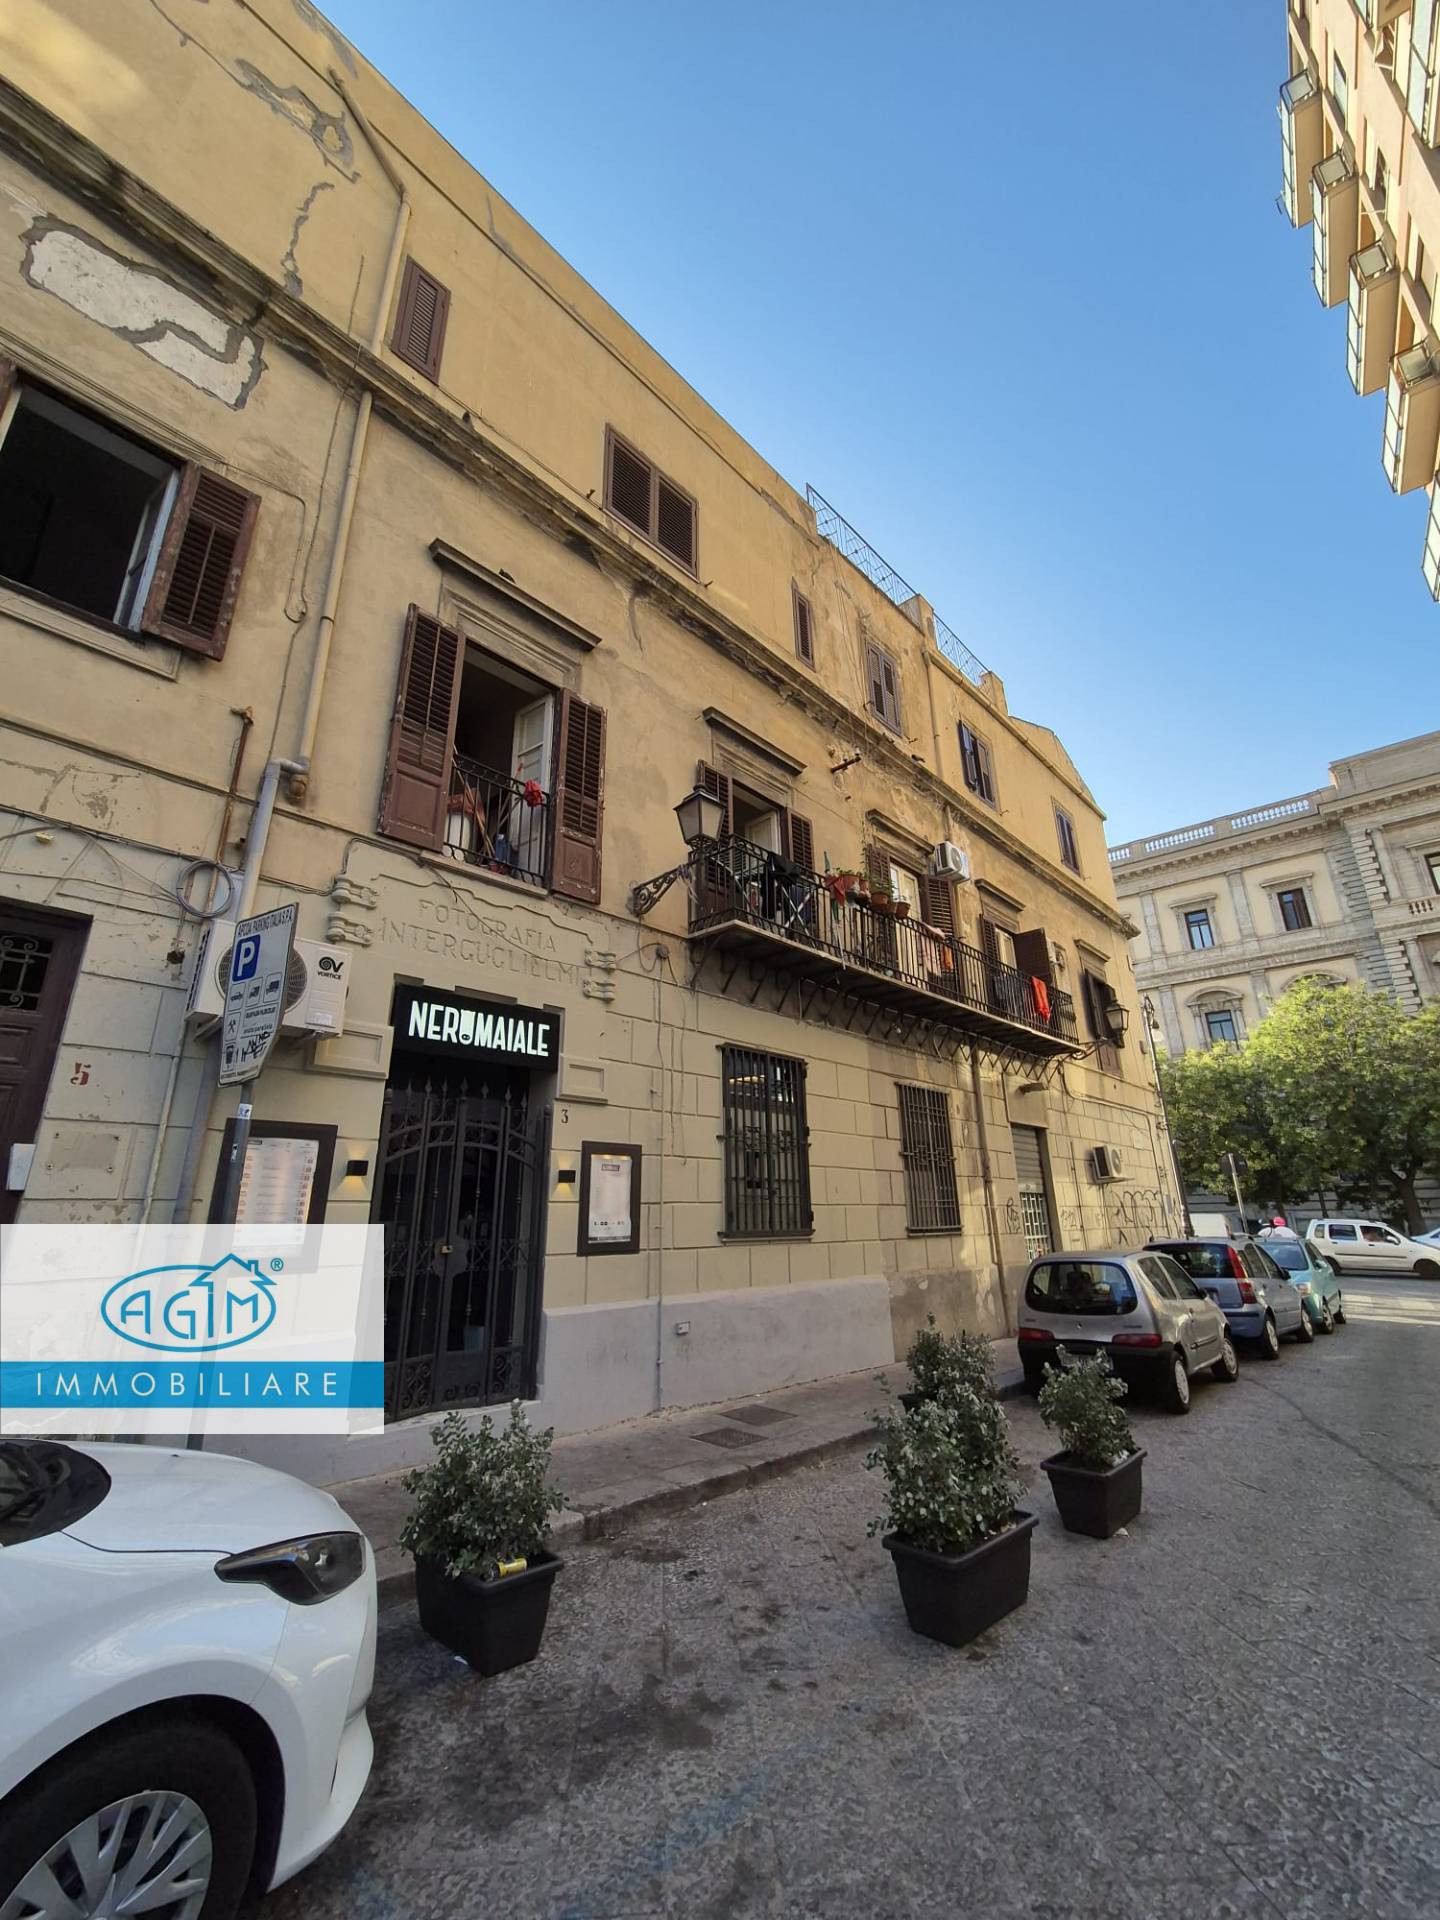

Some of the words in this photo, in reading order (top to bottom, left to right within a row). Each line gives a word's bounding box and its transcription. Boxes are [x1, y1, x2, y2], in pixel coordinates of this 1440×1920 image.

[418, 899, 556, 952] FOTOGRAFIA
[236, 941, 256, 977] P
[70, 1062, 91, 1086] 5
[561, 1109, 569, 1124] 3
